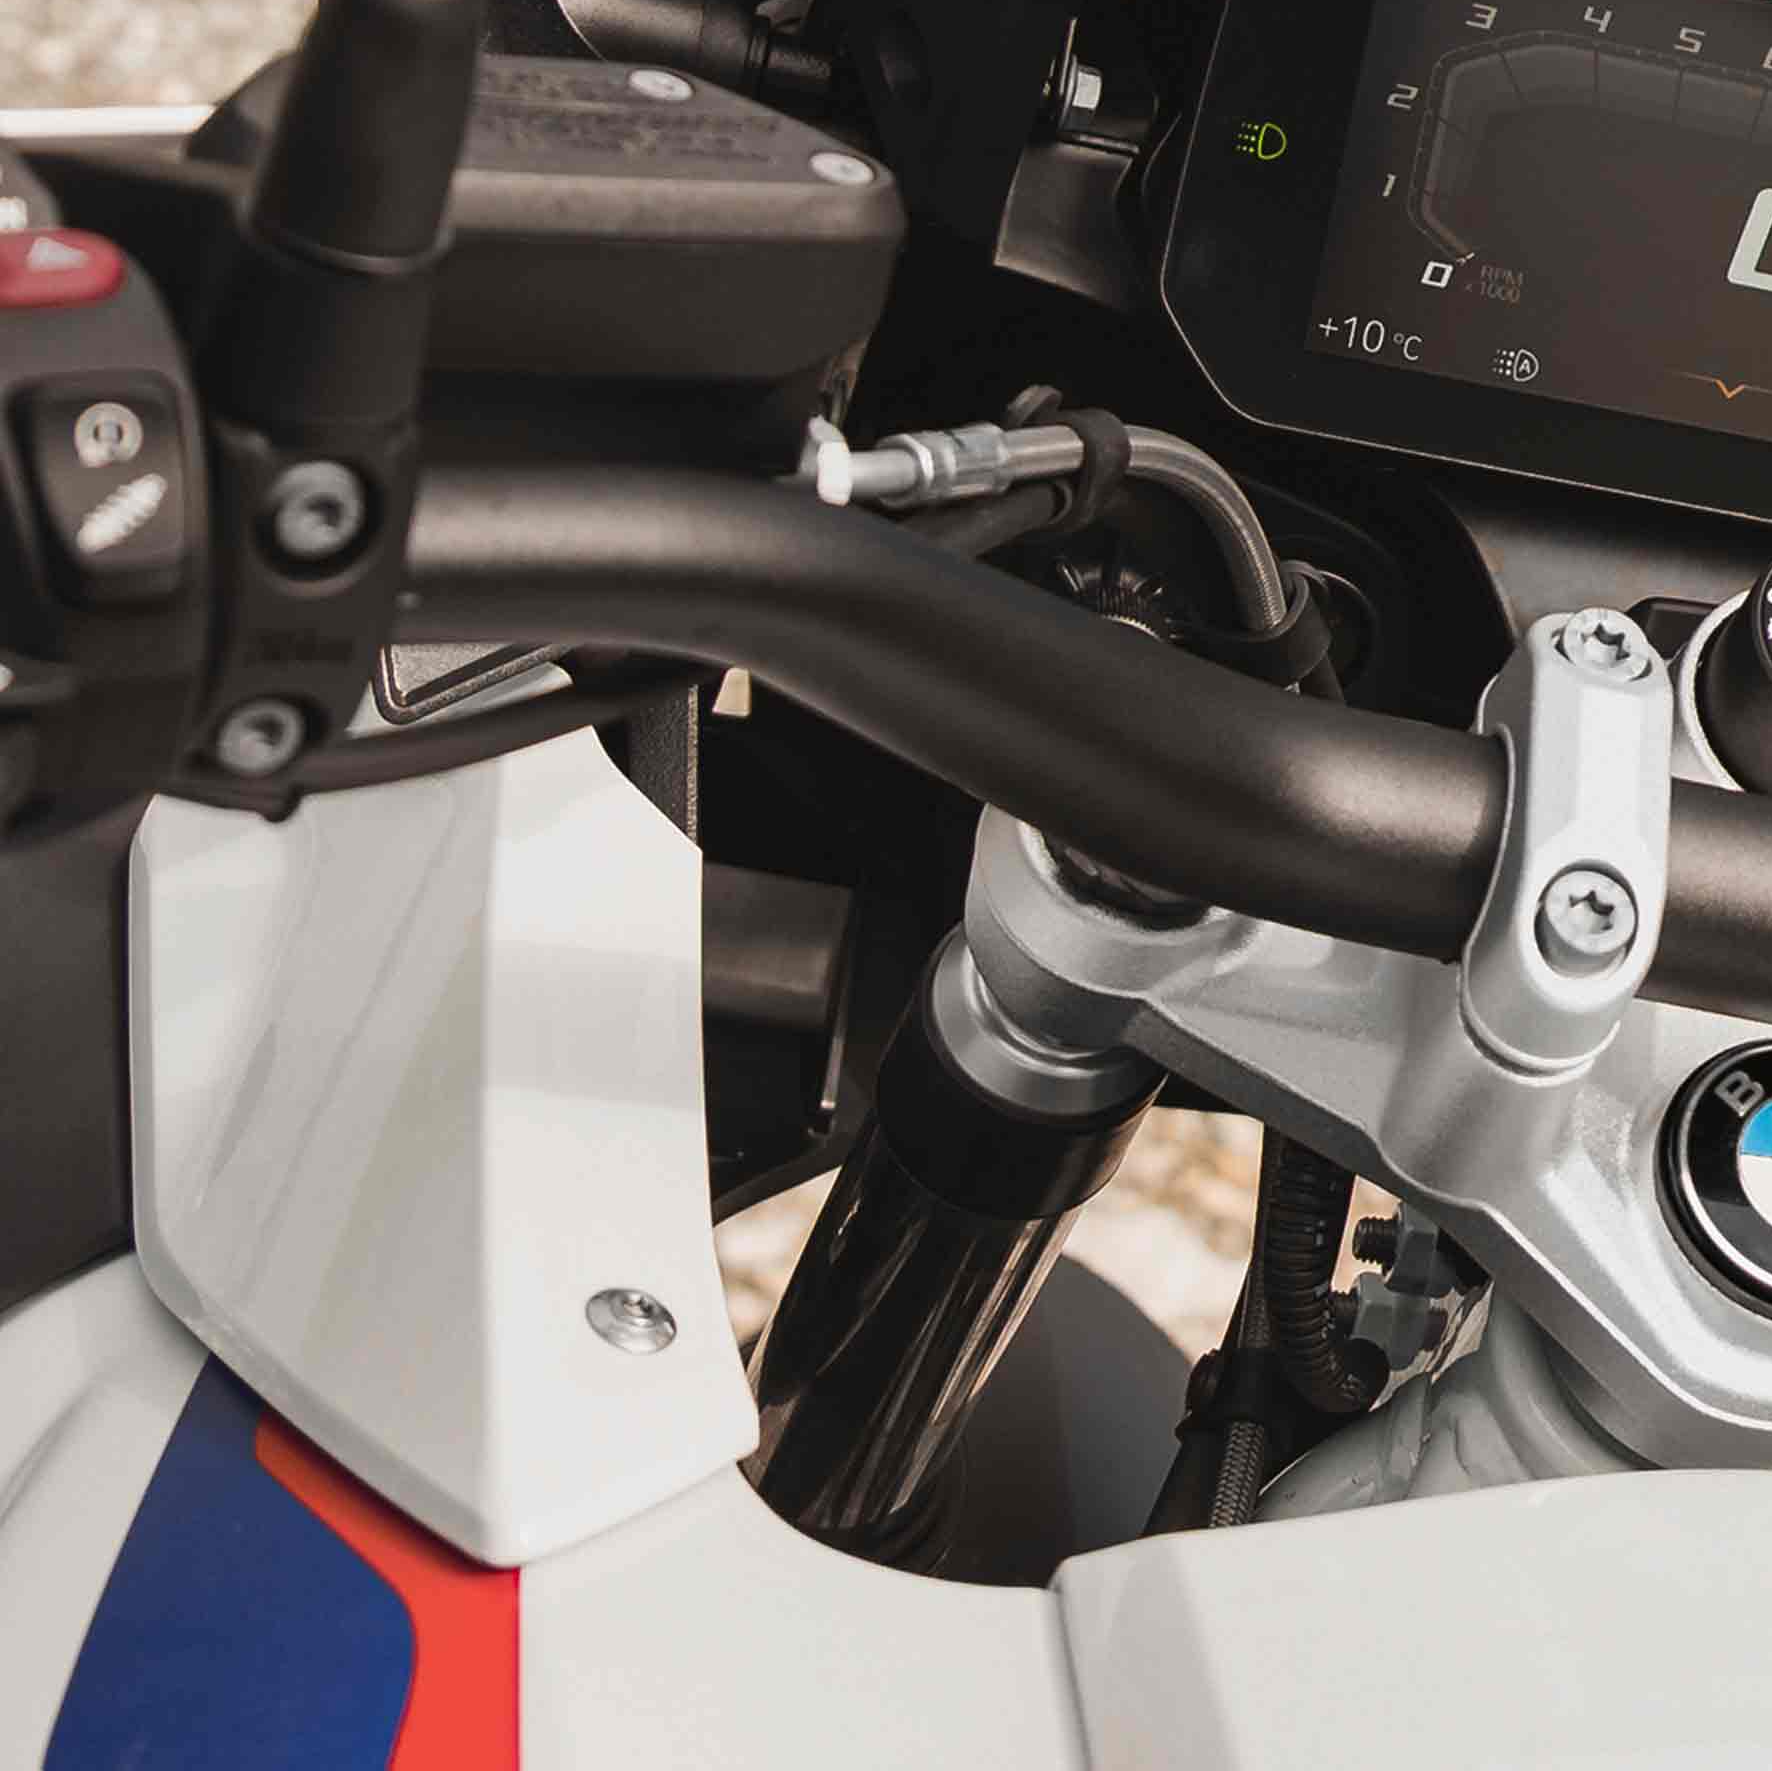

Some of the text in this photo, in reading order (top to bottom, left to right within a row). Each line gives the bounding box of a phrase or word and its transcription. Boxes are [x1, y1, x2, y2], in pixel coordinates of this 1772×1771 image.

[1465, 3, 1498, 29] 3
[1583, 6, 1612, 33] 4
[1673, 27, 1706, 54] 5
[1387, 84, 1419, 109] 2
[1383, 173, 1396, 196] 1
[1421, 261, 1453, 289] 0
[1319, 316, 1385, 353] +10
